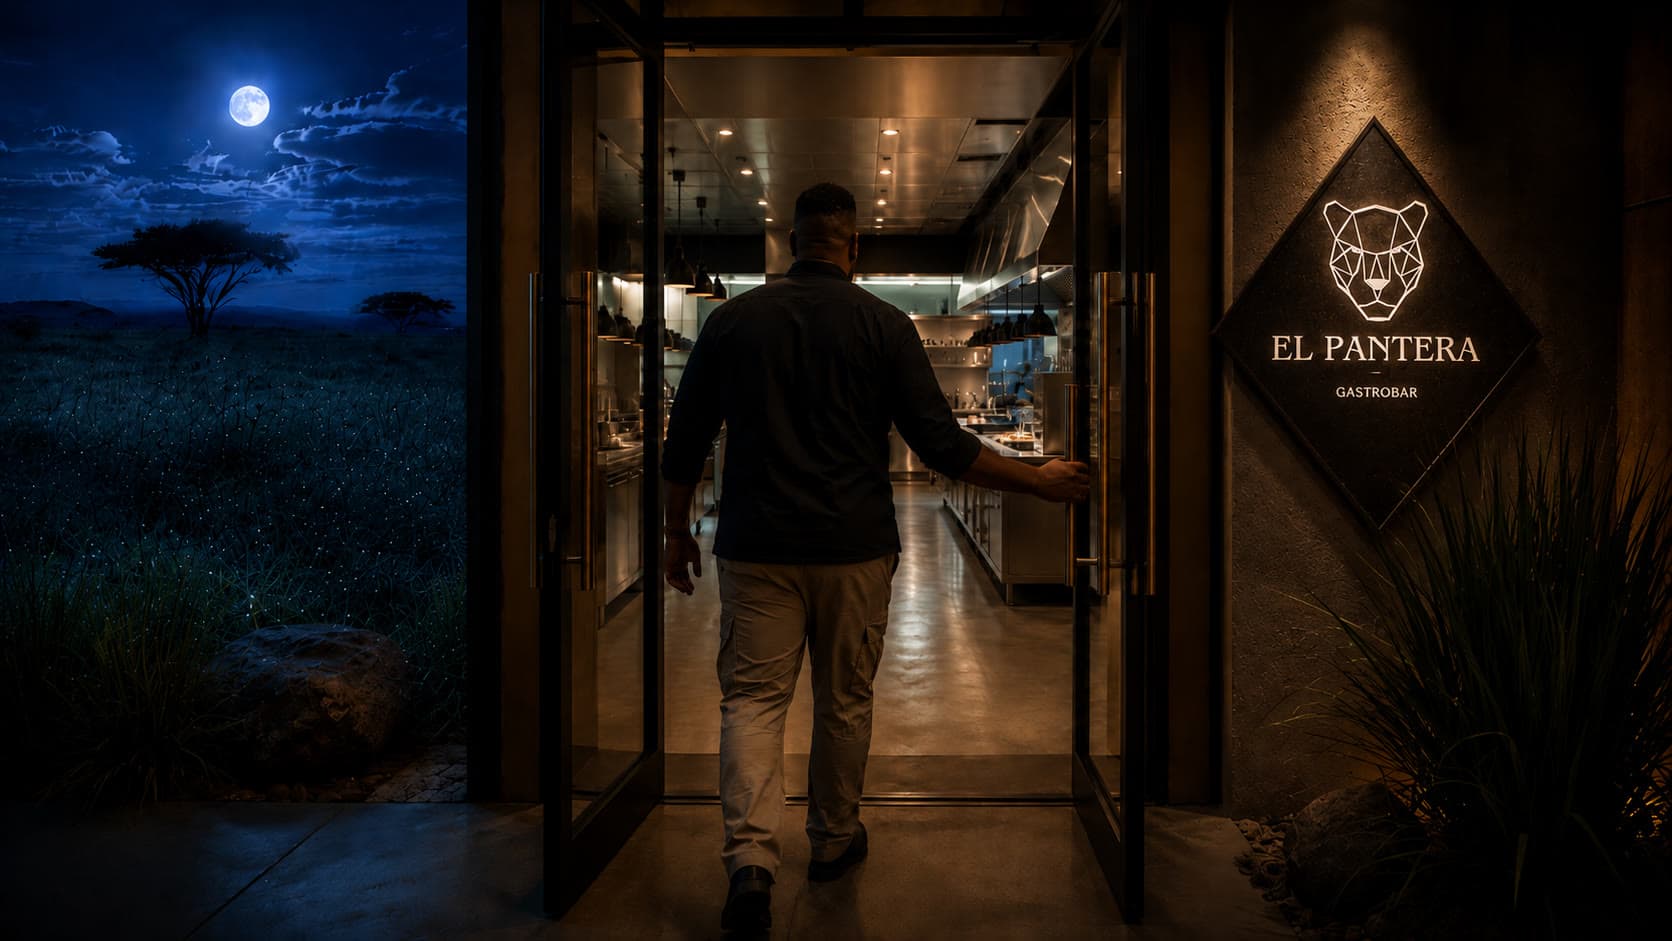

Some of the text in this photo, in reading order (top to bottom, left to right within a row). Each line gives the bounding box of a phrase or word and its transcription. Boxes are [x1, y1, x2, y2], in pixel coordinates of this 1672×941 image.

[1271, 335, 1481, 362] EL PANTERA
[1335, 386, 1418, 398] GASTROBAR
